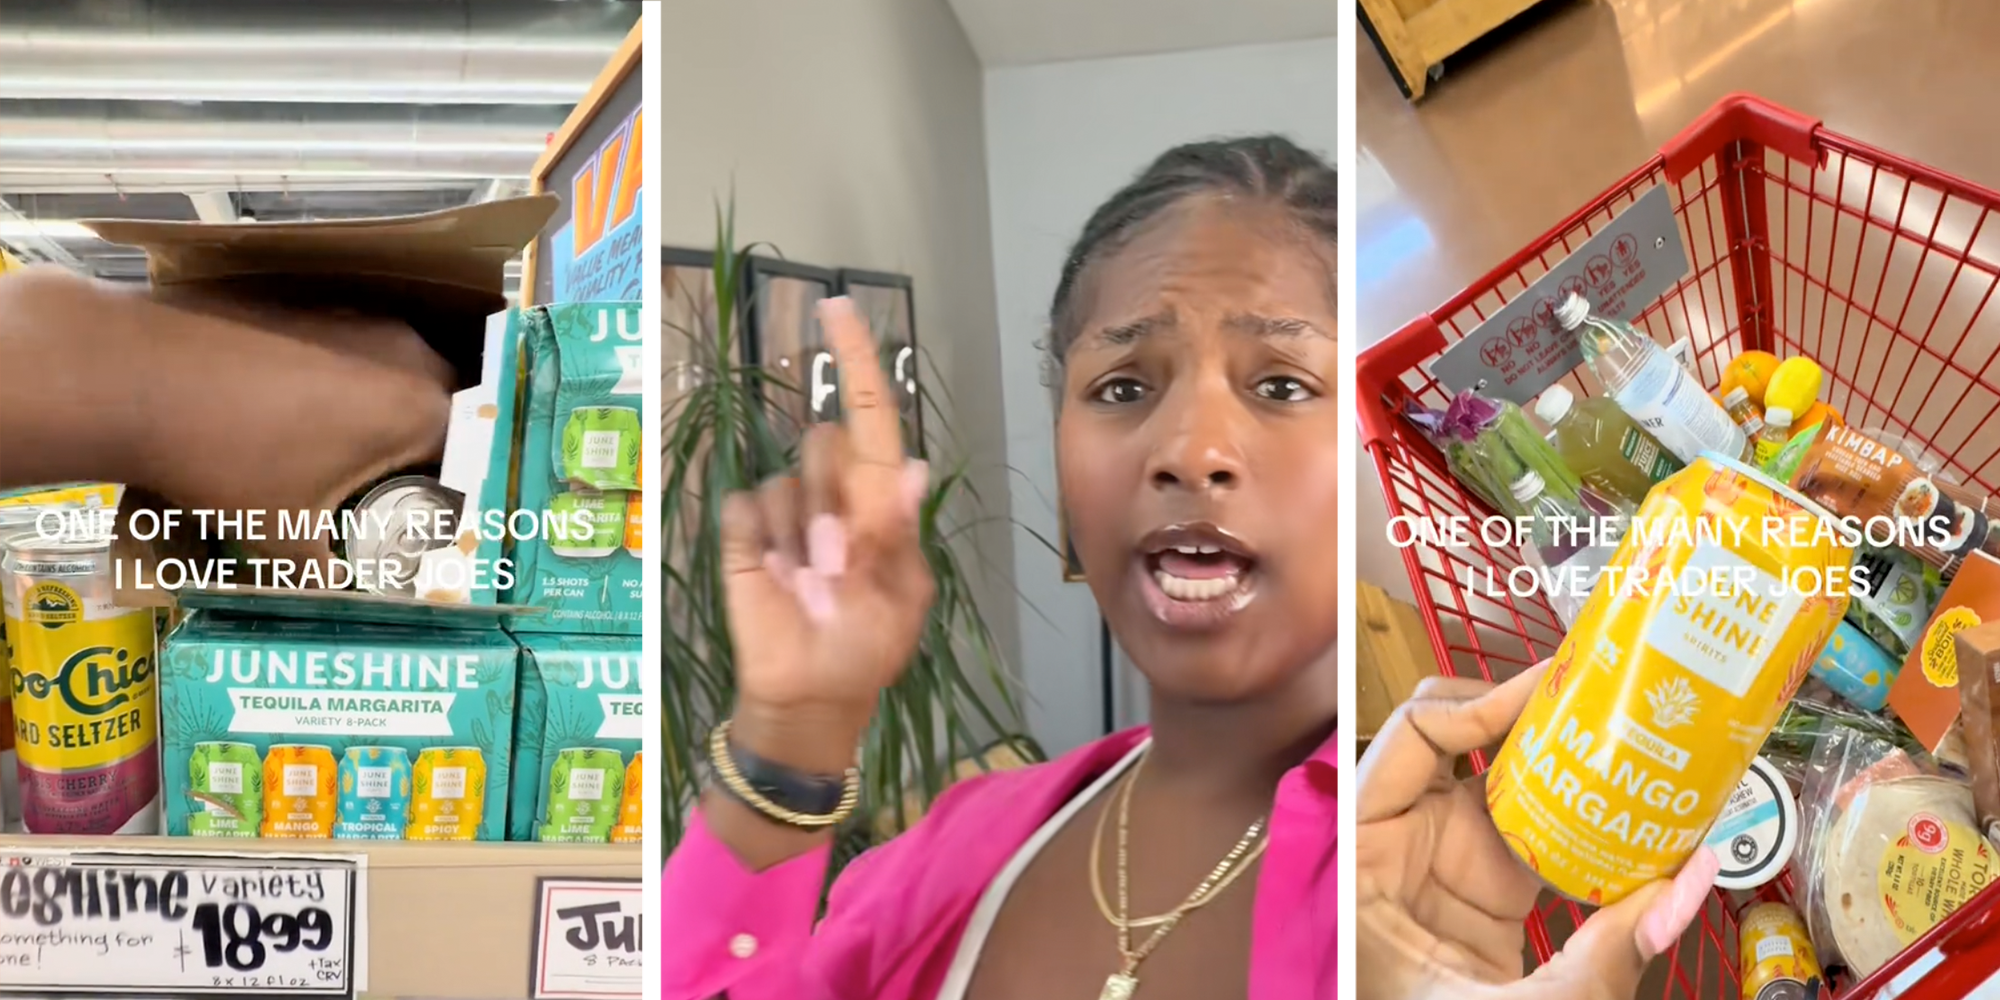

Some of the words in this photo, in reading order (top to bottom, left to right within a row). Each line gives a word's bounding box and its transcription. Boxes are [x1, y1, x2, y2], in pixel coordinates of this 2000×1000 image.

[1501, 361, 1517, 374] NO
[1525, 341, 1541, 355] NO
[1504, 373, 1518, 386] DO
[1517, 360, 1535, 378] NOT
[1825, 424, 1904, 467] KIMBAP
[573, 498, 605, 509] LIME
[542, 578, 556, 587] 1.5
[557, 578, 589, 587] SHOTS
[622, 580, 638, 588] NO
[543, 588, 562, 597] PER
[563, 588, 584, 598] CAN
[552, 609, 584, 619] CONTAINS
[585, 610, 614, 620] ALCOHOL
[1673, 594, 1768, 656] SHINE
[1684, 631, 1727, 663] SPIRITS
[206, 648, 480, 689] JUNESHINE
[239, 696, 322, 711] TEQUILA
[327, 698, 443, 714] MARGARITA
[48, 708, 141, 748] SELTZER
[295, 716, 342, 727] VARIETY
[346, 718, 387, 727] 8-PACK
[1559, 715, 1699, 816] MANGO
[57, 769, 118, 790] CHERRY
[209, 818, 239, 829] LIME
[274, 822, 319, 832] MANGO
[341, 822, 398, 832] TROPICAL
[423, 825, 461, 834] SPICY
[560, 824, 590, 834] LIME
[1918, 824, 1938, 843] 9g
[1945, 847, 1965, 895] WHOLE
[201, 870, 325, 901] Variety
[1916, 877, 1924, 887] 10
[116, 931, 153, 947] for
[583, 954, 598, 967] 8
[242, 975, 260, 986] 12
[316, 970, 343, 982] CRV
